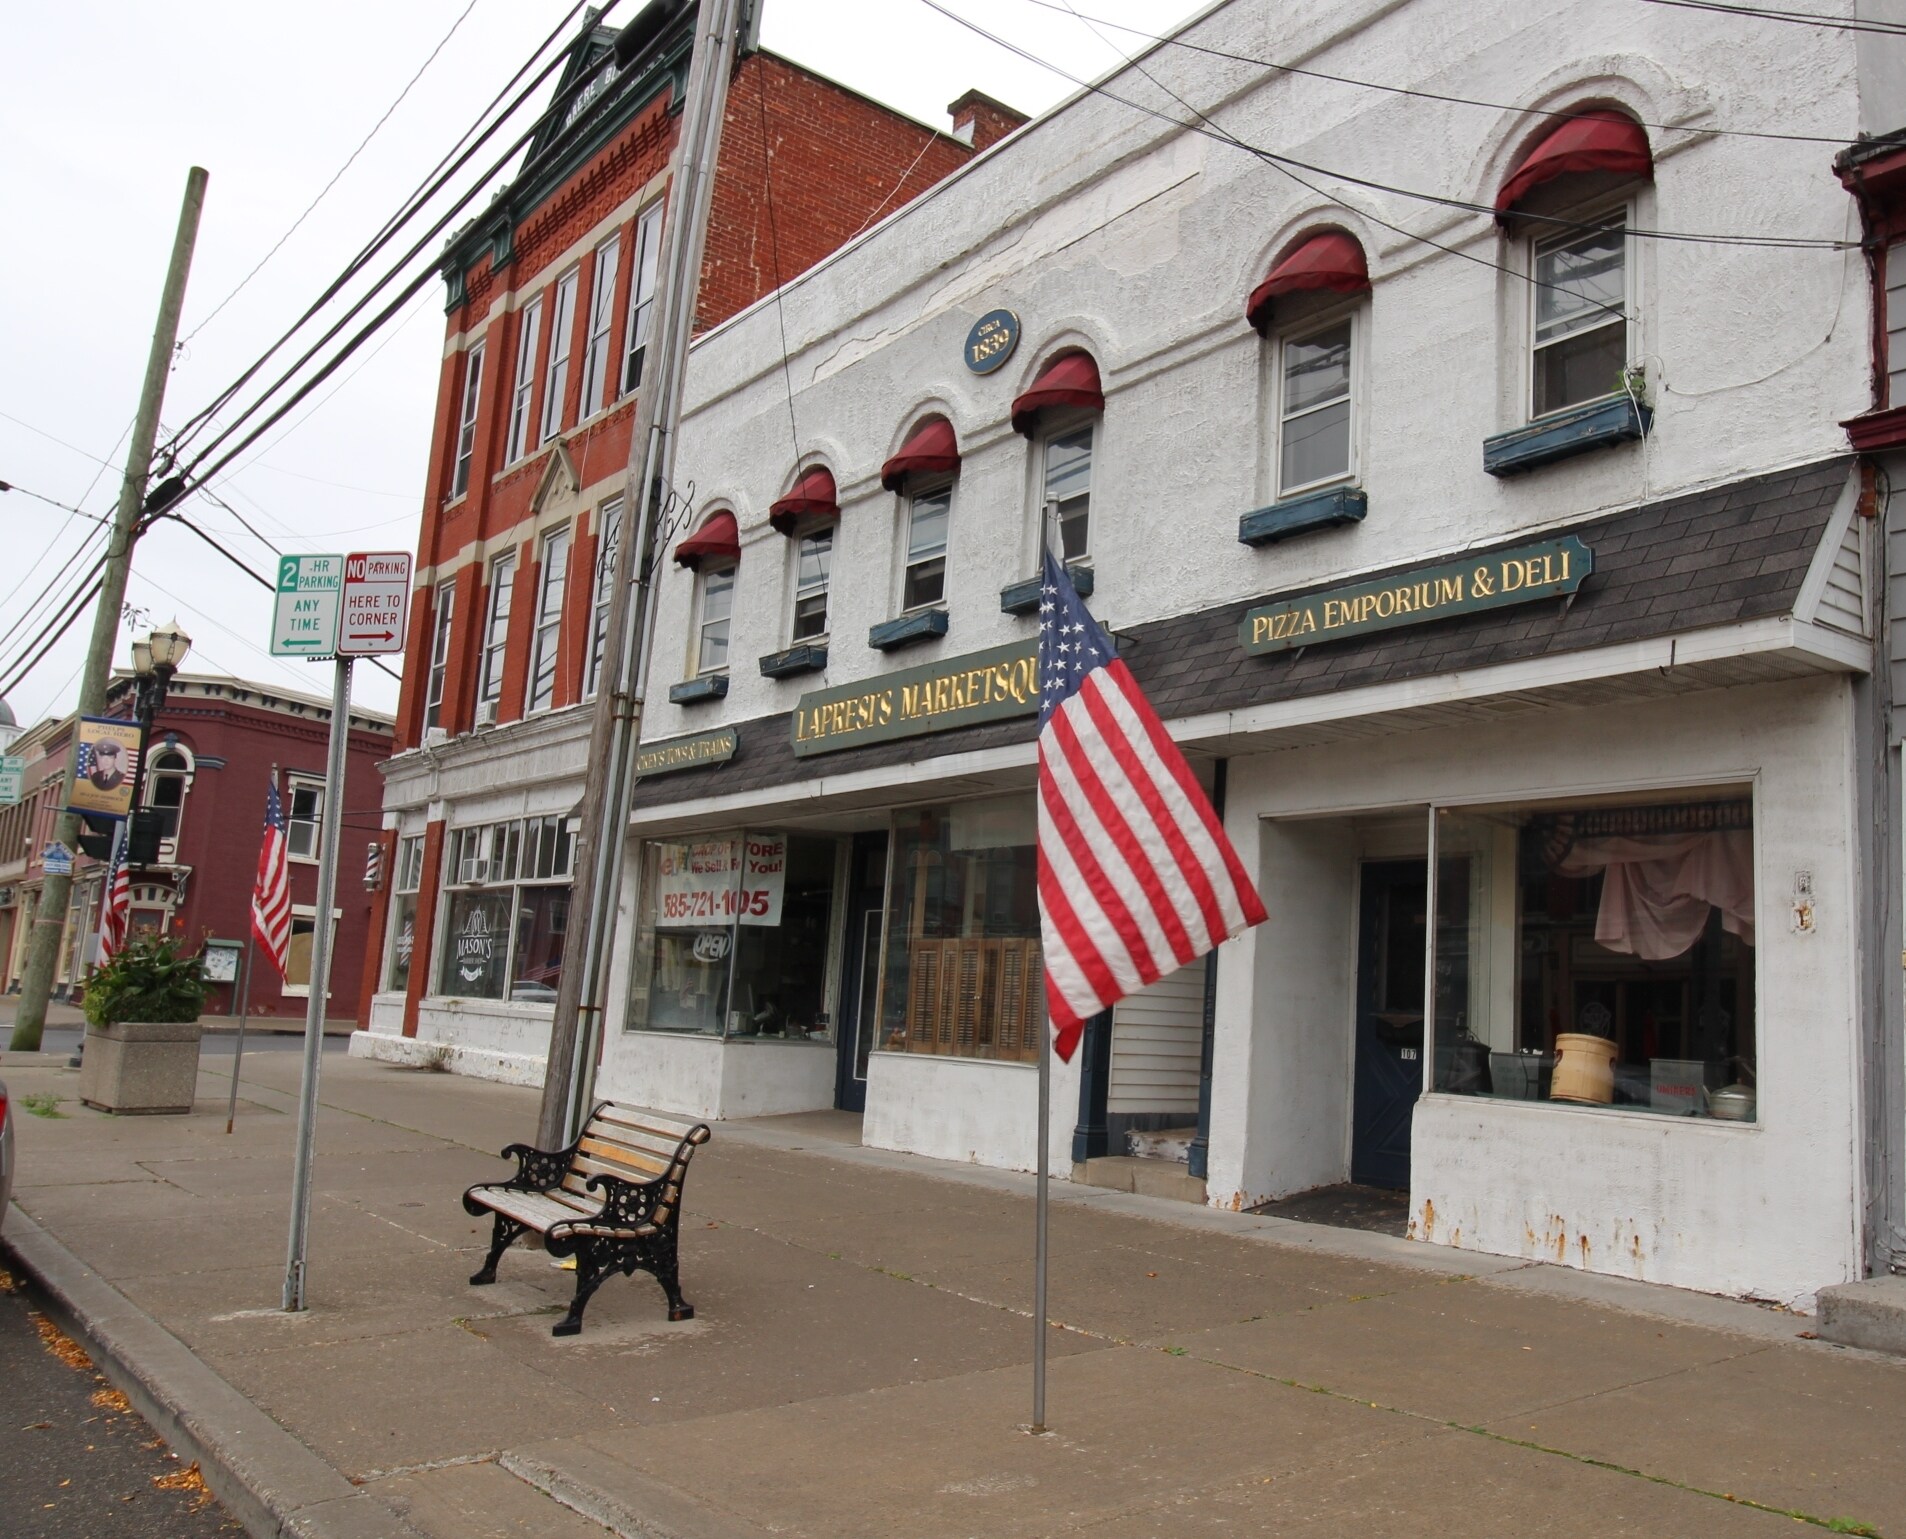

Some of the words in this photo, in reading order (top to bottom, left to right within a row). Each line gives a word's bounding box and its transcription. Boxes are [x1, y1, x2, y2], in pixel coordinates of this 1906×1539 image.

[978, 320, 1000, 336] CIRCA
[282, 562, 297, 587] 2
[347, 560, 366, 578] NO
[368, 561, 406, 575] PARKING
[299, 575, 339, 589] PARKING
[349, 595, 380, 608] HERE
[387, 595, 400, 608] TO
[1252, 608, 1316, 645] PIZZA
[1323, 574, 1463, 629] EMPORIUM
[1471, 566, 1495, 598] &
[1501, 551, 1570, 593] DELI
[294, 600, 320, 612] ANY
[290, 618, 320, 631] TIME
[349, 612, 398, 625] CORNER
[797, 689, 893, 742] LAPRESI'S
[88, 728, 112, 736] LOCAL
[698, 736, 732, 759] TRAINS
[749, 860, 783, 874] You!
[456, 938, 492, 960] MASON'S
[696, 932, 727, 958] OPEN
[1401, 1049, 1416, 1060] 107
